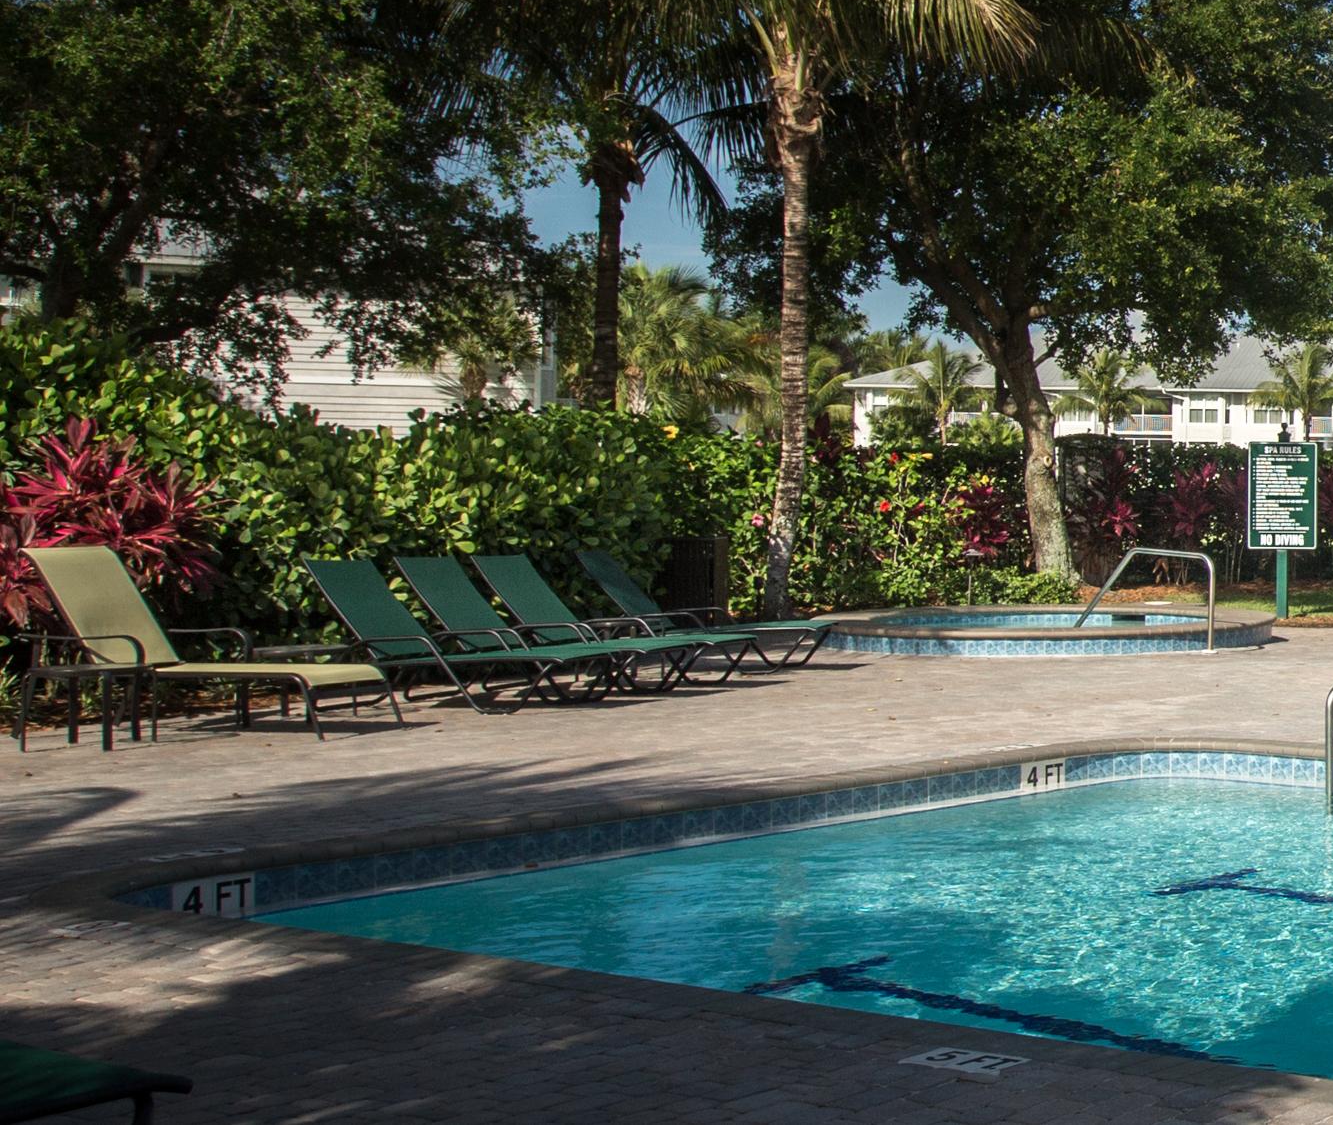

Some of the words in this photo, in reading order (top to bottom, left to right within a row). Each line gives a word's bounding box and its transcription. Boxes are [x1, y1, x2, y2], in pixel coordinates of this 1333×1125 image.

[1264, 446, 1278, 454] SPA
[1280, 446, 1302, 454] RULES
[1260, 534, 1273, 546] NO
[1275, 534, 1304, 546] DIVING
[1027, 766, 1039, 787] 4
[1045, 763, 1064, 785] FT
[183, 886, 203, 914] 4
[216, 877, 252, 911] FT
[925, 1050, 970, 1062] 5
